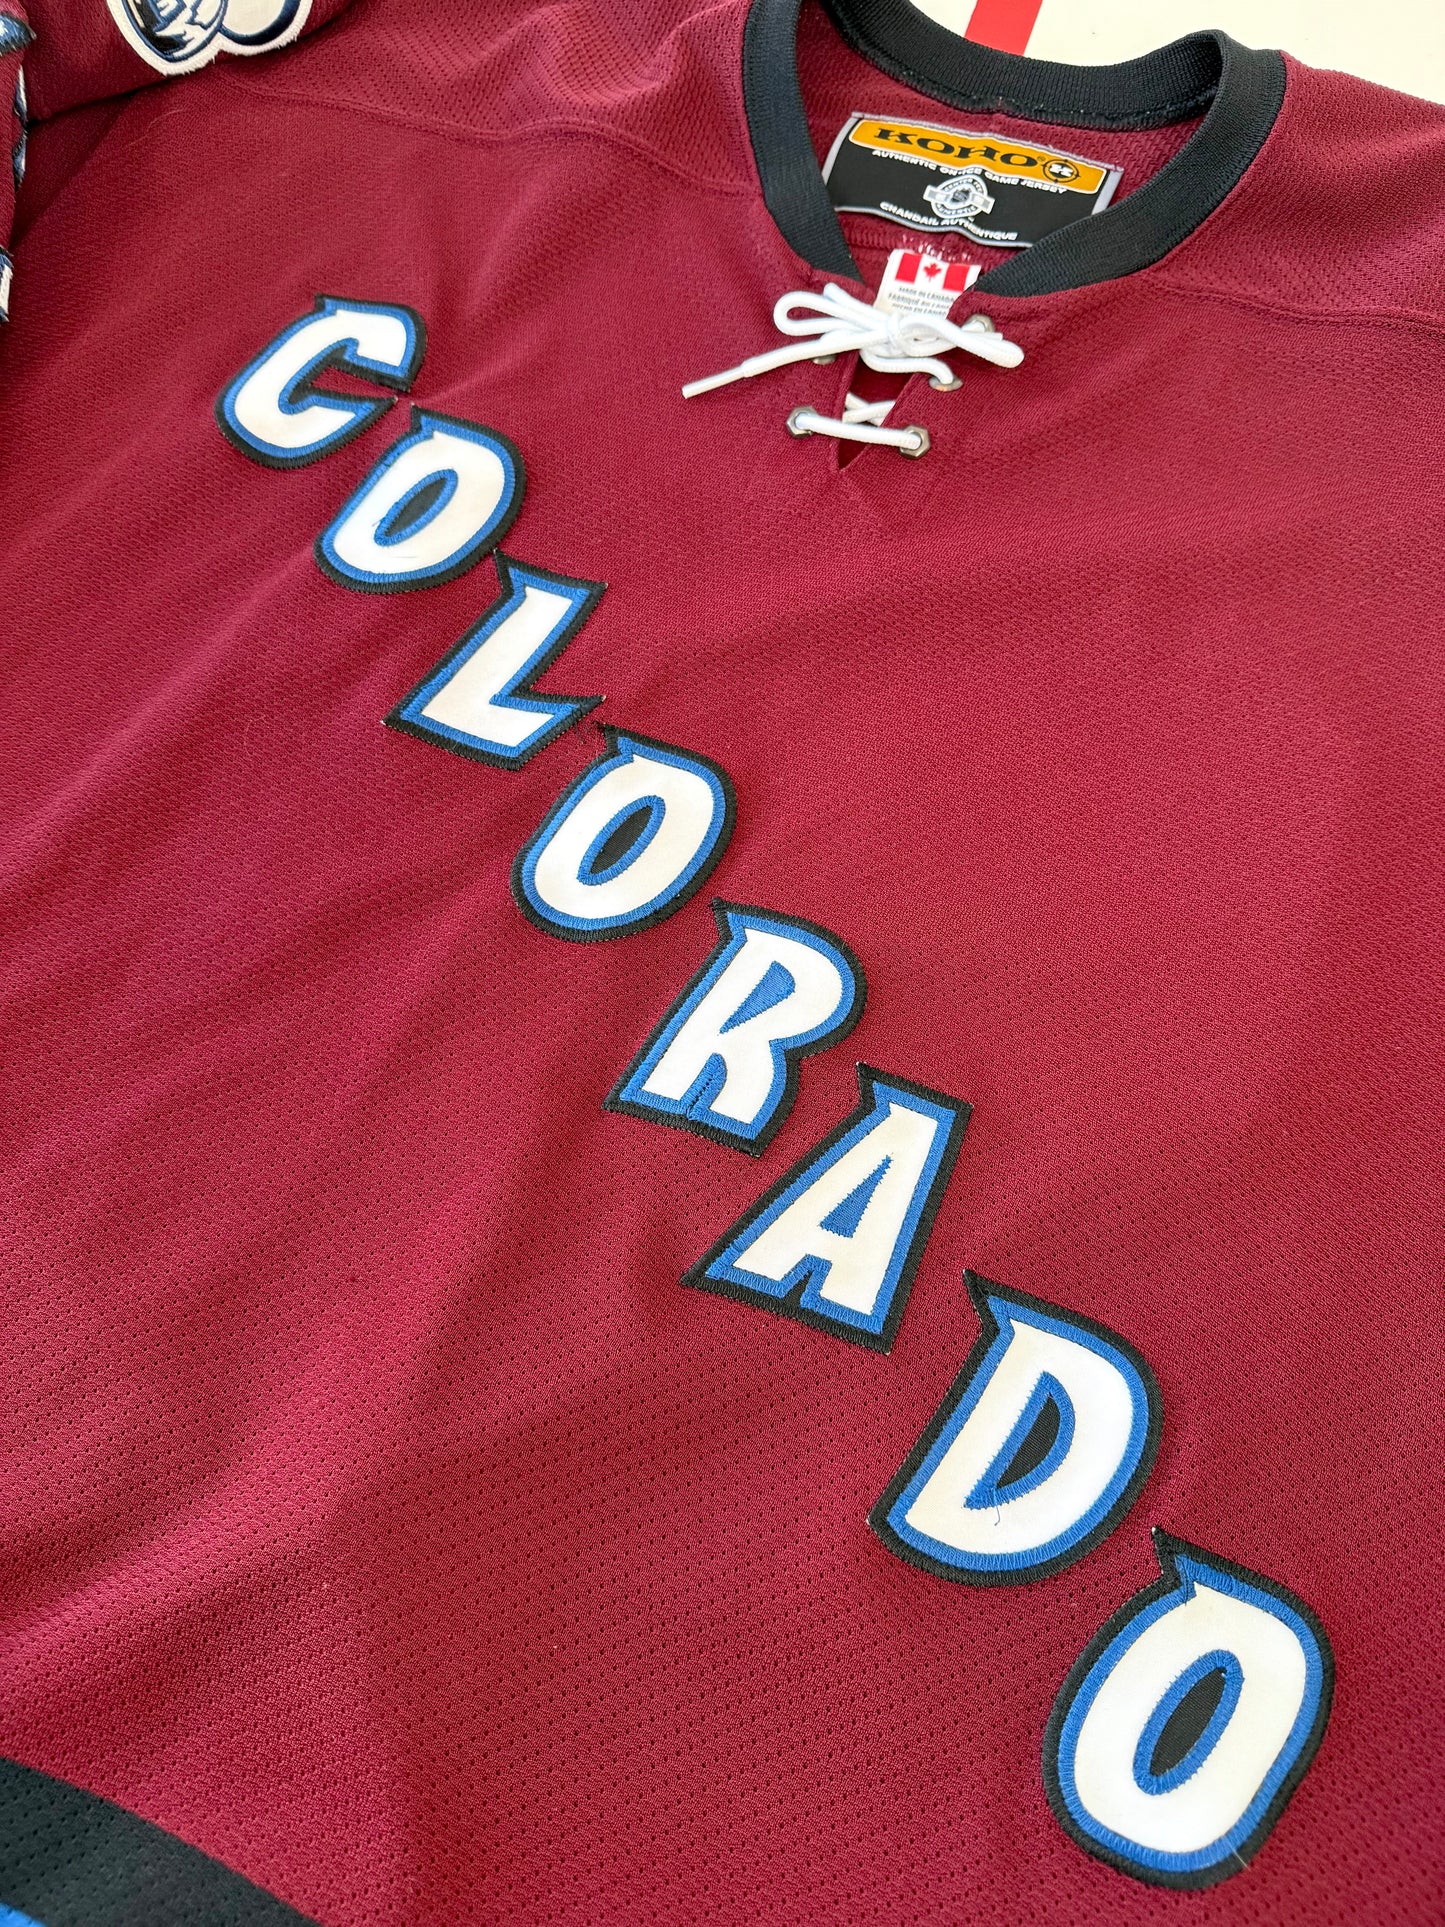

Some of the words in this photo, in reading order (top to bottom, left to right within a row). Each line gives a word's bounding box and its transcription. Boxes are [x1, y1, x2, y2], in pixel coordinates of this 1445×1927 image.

[873, 128, 1038, 168] KOHO
[871, 149, 938, 172] AUTHENTIC
[939, 166, 983, 177] ON-ICE
[984, 171, 1019, 186] GAME
[1020, 178, 1068, 195] JERSEY
[879, 201, 940, 226] CHANDAIL
[940, 217, 1018, 241] AUTHENTIQUE
[213, 294, 1336, 1890] COLORADO
